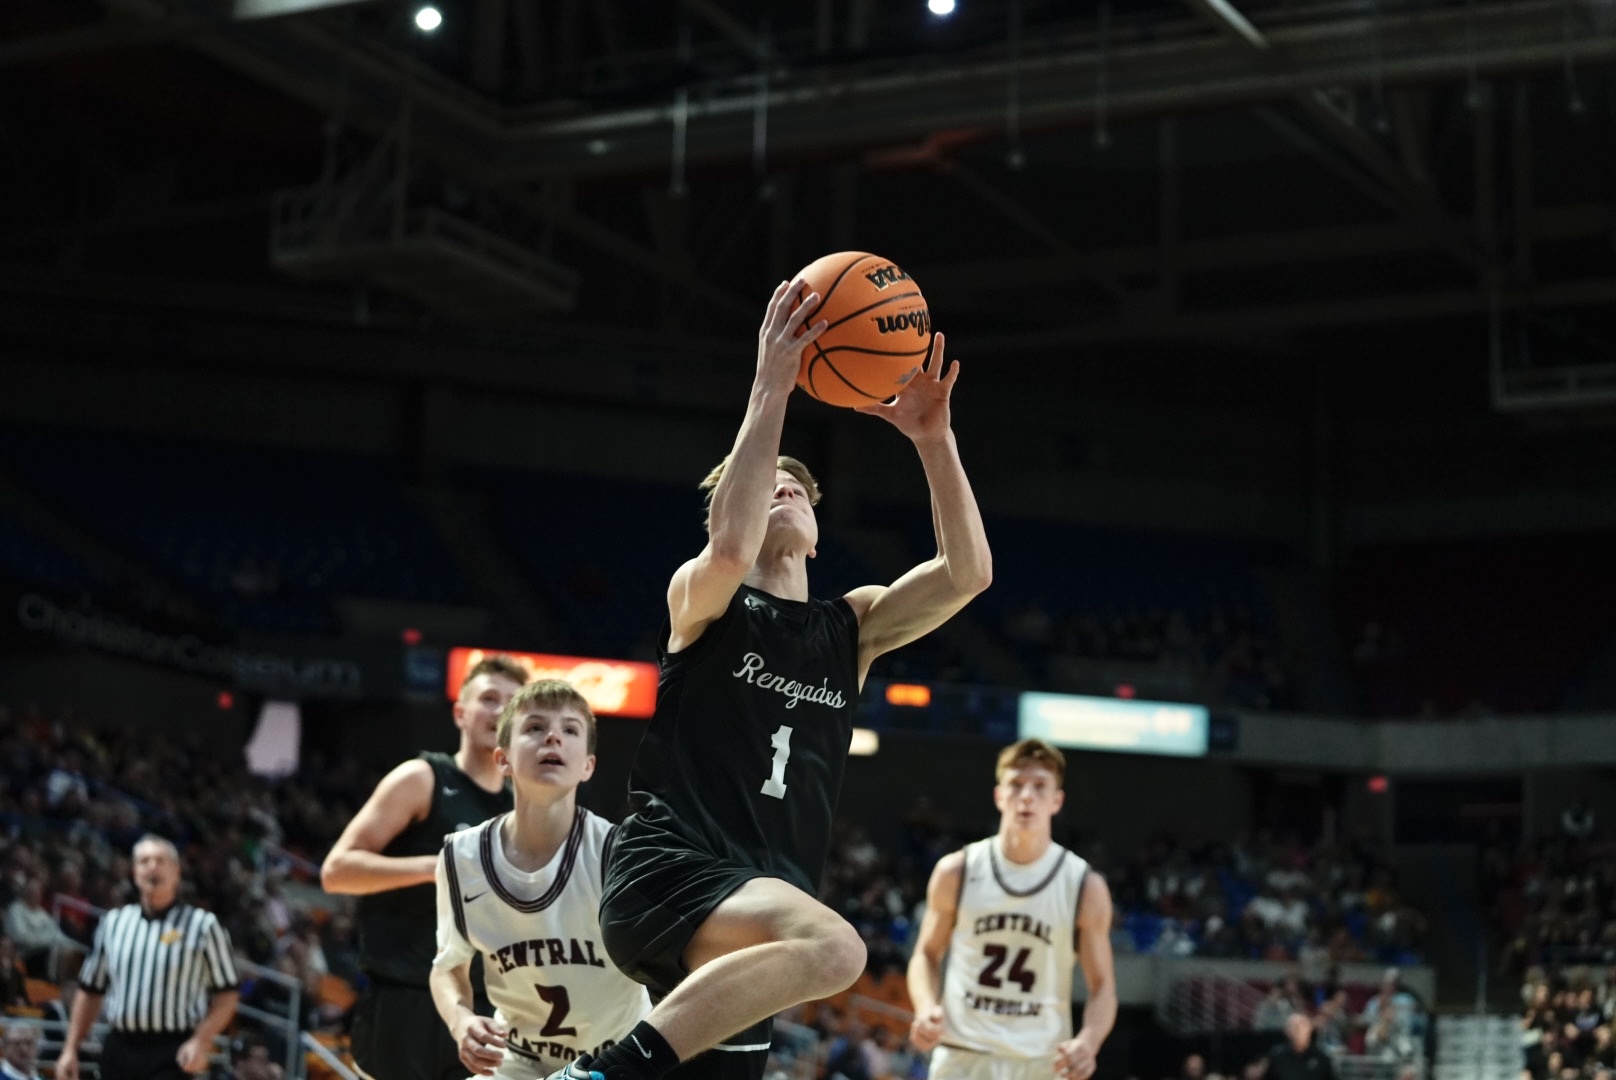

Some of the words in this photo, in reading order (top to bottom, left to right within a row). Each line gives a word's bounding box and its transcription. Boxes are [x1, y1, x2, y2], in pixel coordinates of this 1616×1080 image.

[865, 265, 912, 291] CAA
[875, 309, 932, 337] ilson
[733, 652, 846, 709] Renegades
[760, 725, 793, 800] 1
[974, 913, 1053, 944] CENTRAL
[978, 943, 1036, 993] 24
[535, 983, 577, 1037] 2
